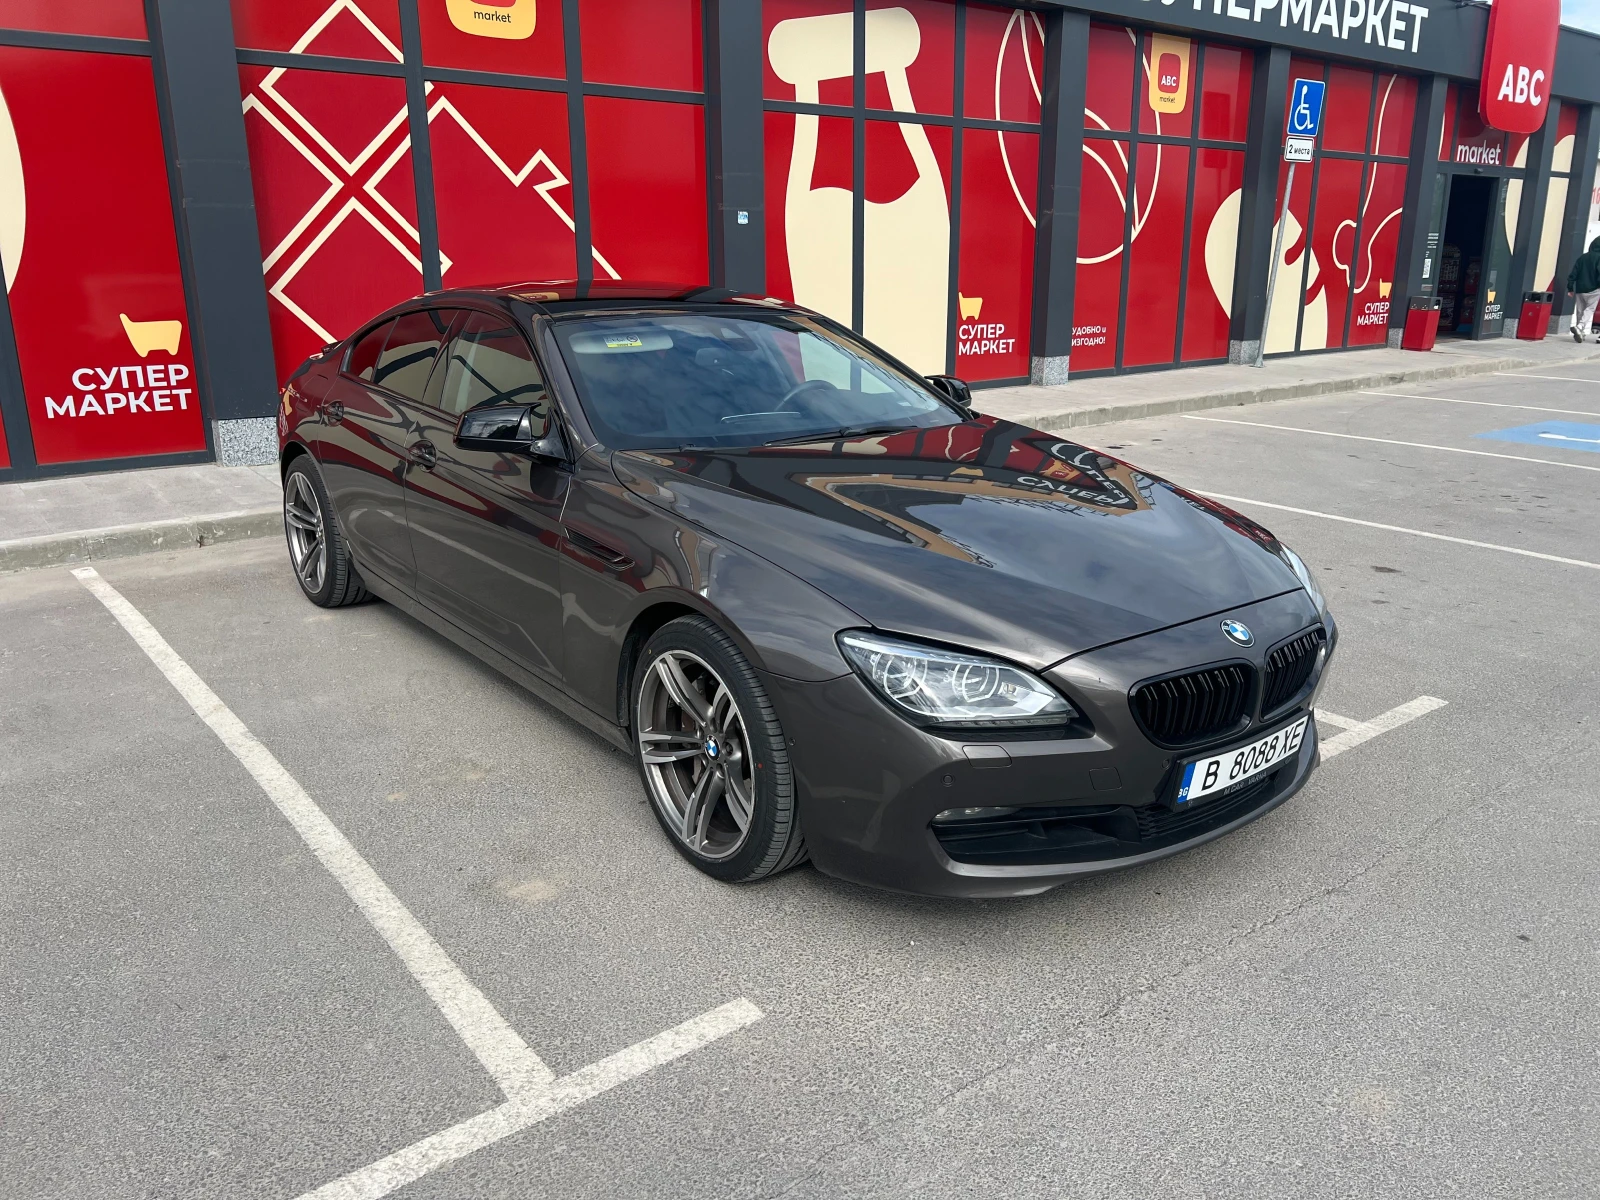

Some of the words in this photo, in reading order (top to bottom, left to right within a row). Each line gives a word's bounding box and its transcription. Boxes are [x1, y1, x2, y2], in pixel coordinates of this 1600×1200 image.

[473, 10, 512, 23] market
[1140, 0, 1429, 53] МАРКЕТ
[1160, 75, 1177, 87] ABC
[1497, 63, 1545, 106] ABC
[1159, 95, 1176, 104] market
[1288, 144, 1294, 154] 2
[1293, 147, 1311, 155] места
[1456, 140, 1501, 165] market
[1364, 301, 1390, 314] СУПЕР
[1356, 313, 1389, 326] МАРКЕТ
[1483, 311, 1504, 321] МАРКЕТ
[958, 323, 1005, 340] СУПЕР
[1071, 326, 1101, 336] УДОБНО
[958, 338, 1016, 356] МАРКЕТ
[1071, 336, 1106, 347] ИЗГОДНО!
[71, 363, 190, 391] СУПЕР
[44, 388, 192, 419] МАРКЕТ
[1201, 759, 1221, 792] B
[1229, 735, 1280, 781] 8088
